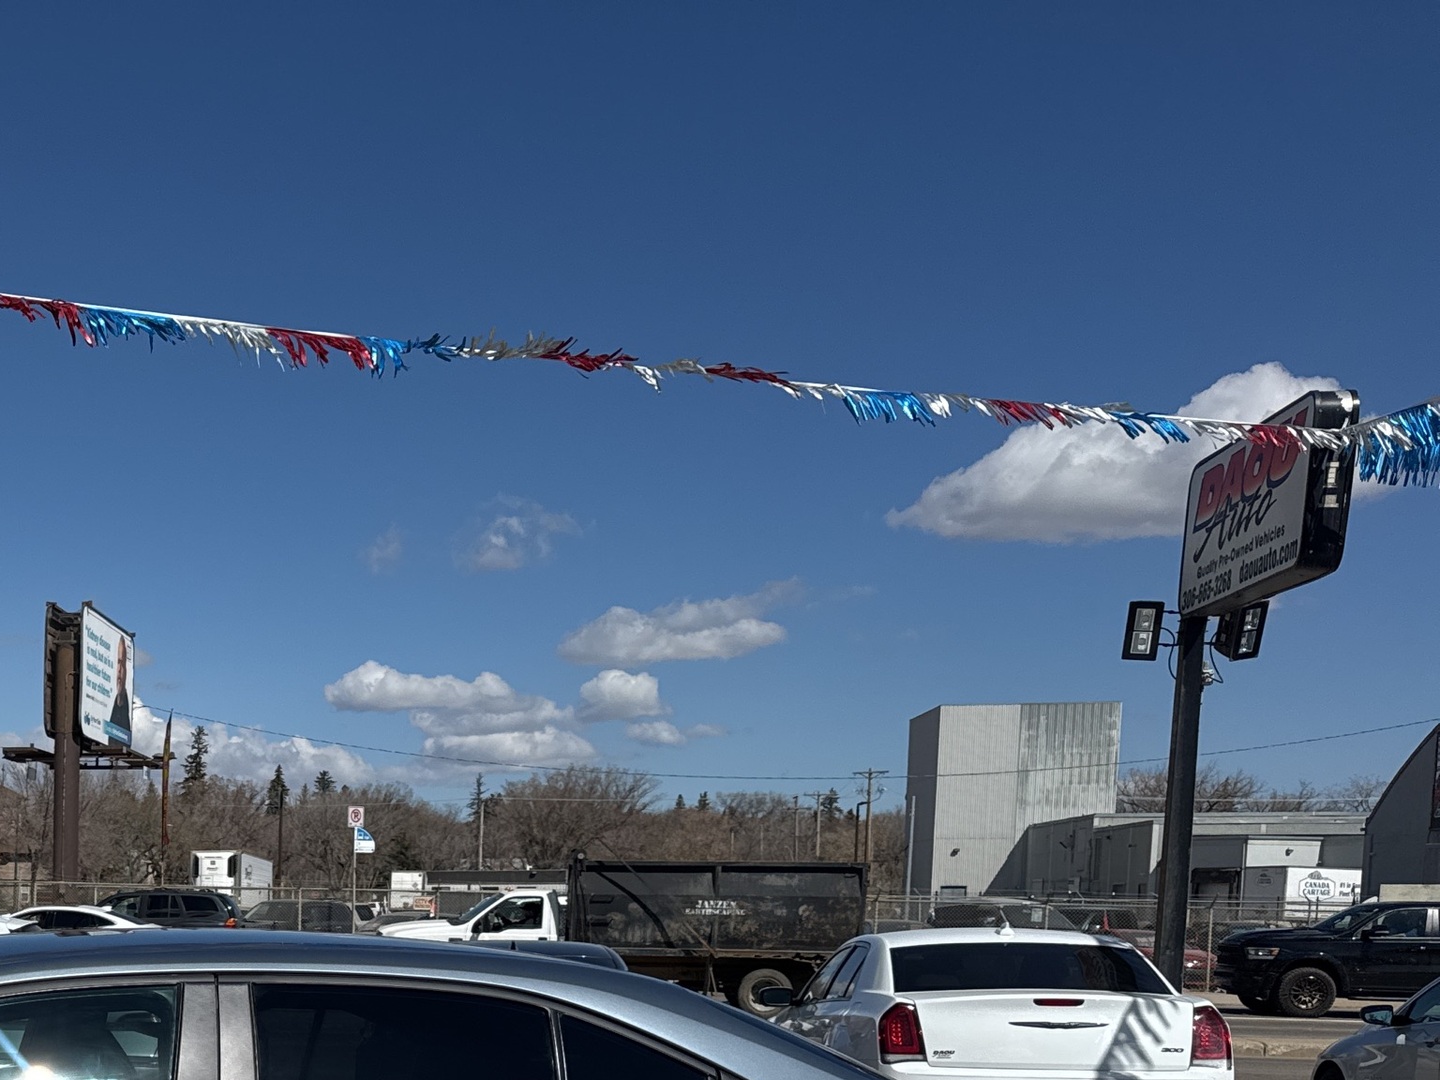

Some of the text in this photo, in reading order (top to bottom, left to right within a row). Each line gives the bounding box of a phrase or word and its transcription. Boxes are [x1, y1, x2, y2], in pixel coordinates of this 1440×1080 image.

[1193, 407, 1308, 533] DAOU
[1193, 486, 1277, 563] Auto
[1197, 525, 1285, 579] Quality Pre-Owned Vehicles
[1181, 539, 1298, 611] 306-665-3268 daouauto.com
[695, 900, 737, 909] JANZEN
